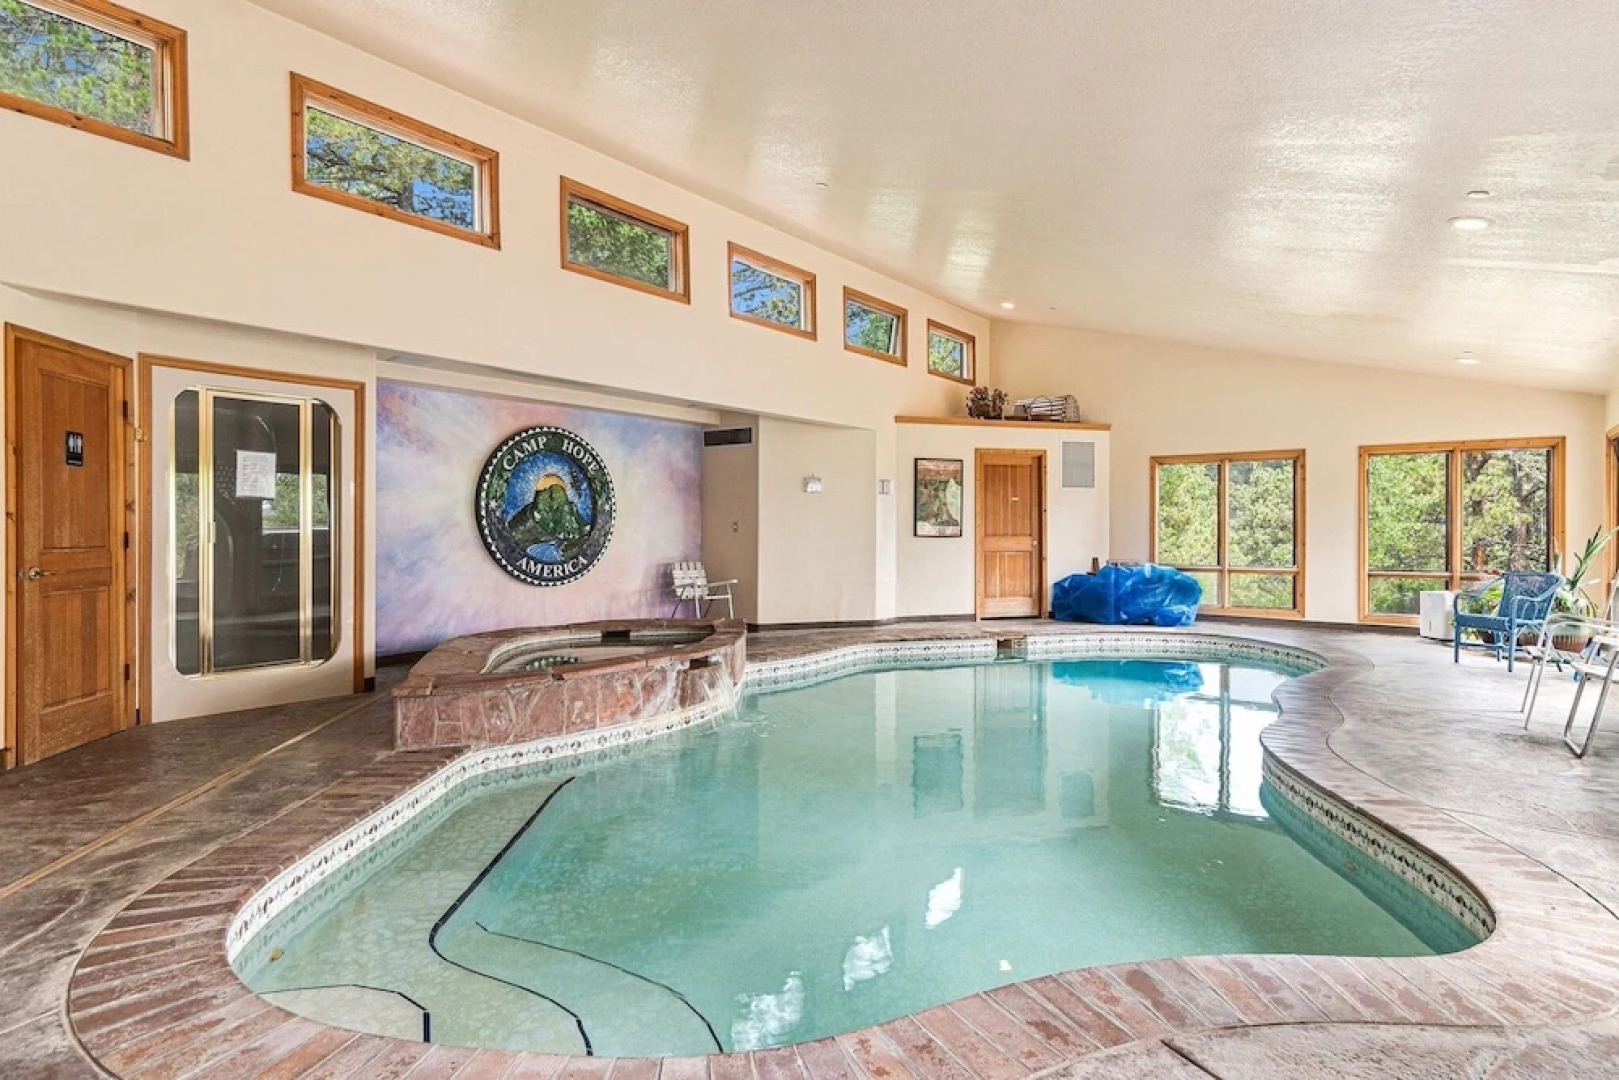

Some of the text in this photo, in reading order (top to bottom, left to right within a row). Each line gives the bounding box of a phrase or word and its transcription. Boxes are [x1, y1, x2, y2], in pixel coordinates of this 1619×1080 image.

[503, 436, 600, 473] CAMP HOPE
[516, 555, 588, 578] AMERICA
